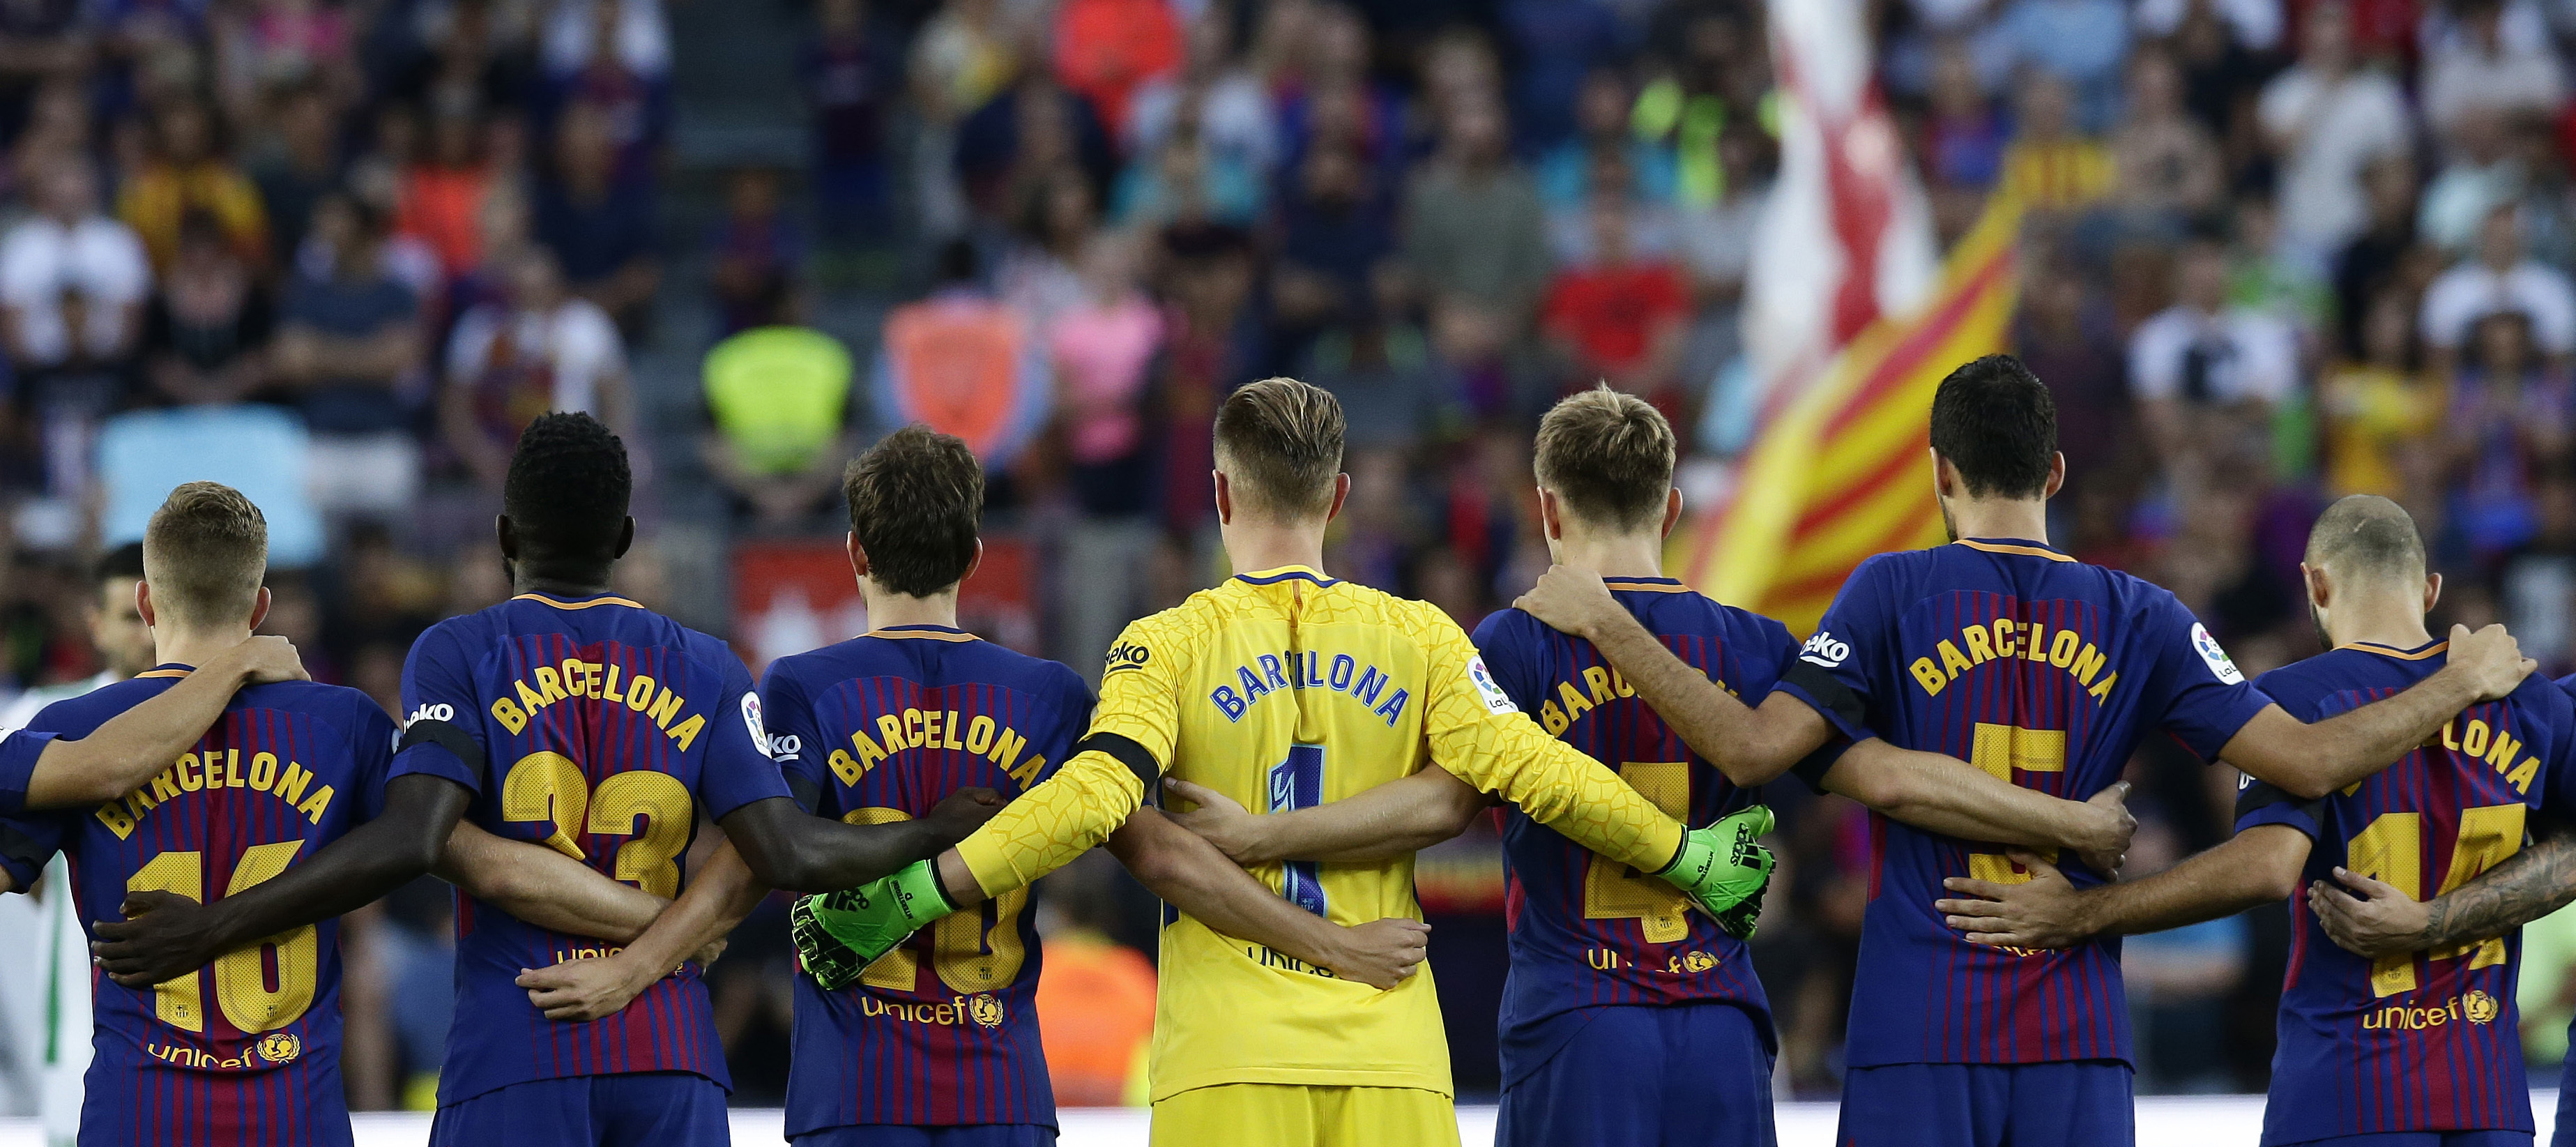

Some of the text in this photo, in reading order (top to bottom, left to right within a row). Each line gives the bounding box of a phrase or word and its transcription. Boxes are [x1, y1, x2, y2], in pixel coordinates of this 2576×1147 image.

[491, 658, 706, 752] BARCELONA
[1210, 650, 1409, 728] BARELONA
[828, 708, 1046, 792] BARCELONA
[96, 748, 335, 841] BARCELONA
[1730, 822, 1749, 867] adidas
[127, 840, 318, 1034] 16
[2347, 803, 2526, 998] 14
[861, 996, 966, 1025] unicef
[2362, 996, 2460, 1030] unicef
